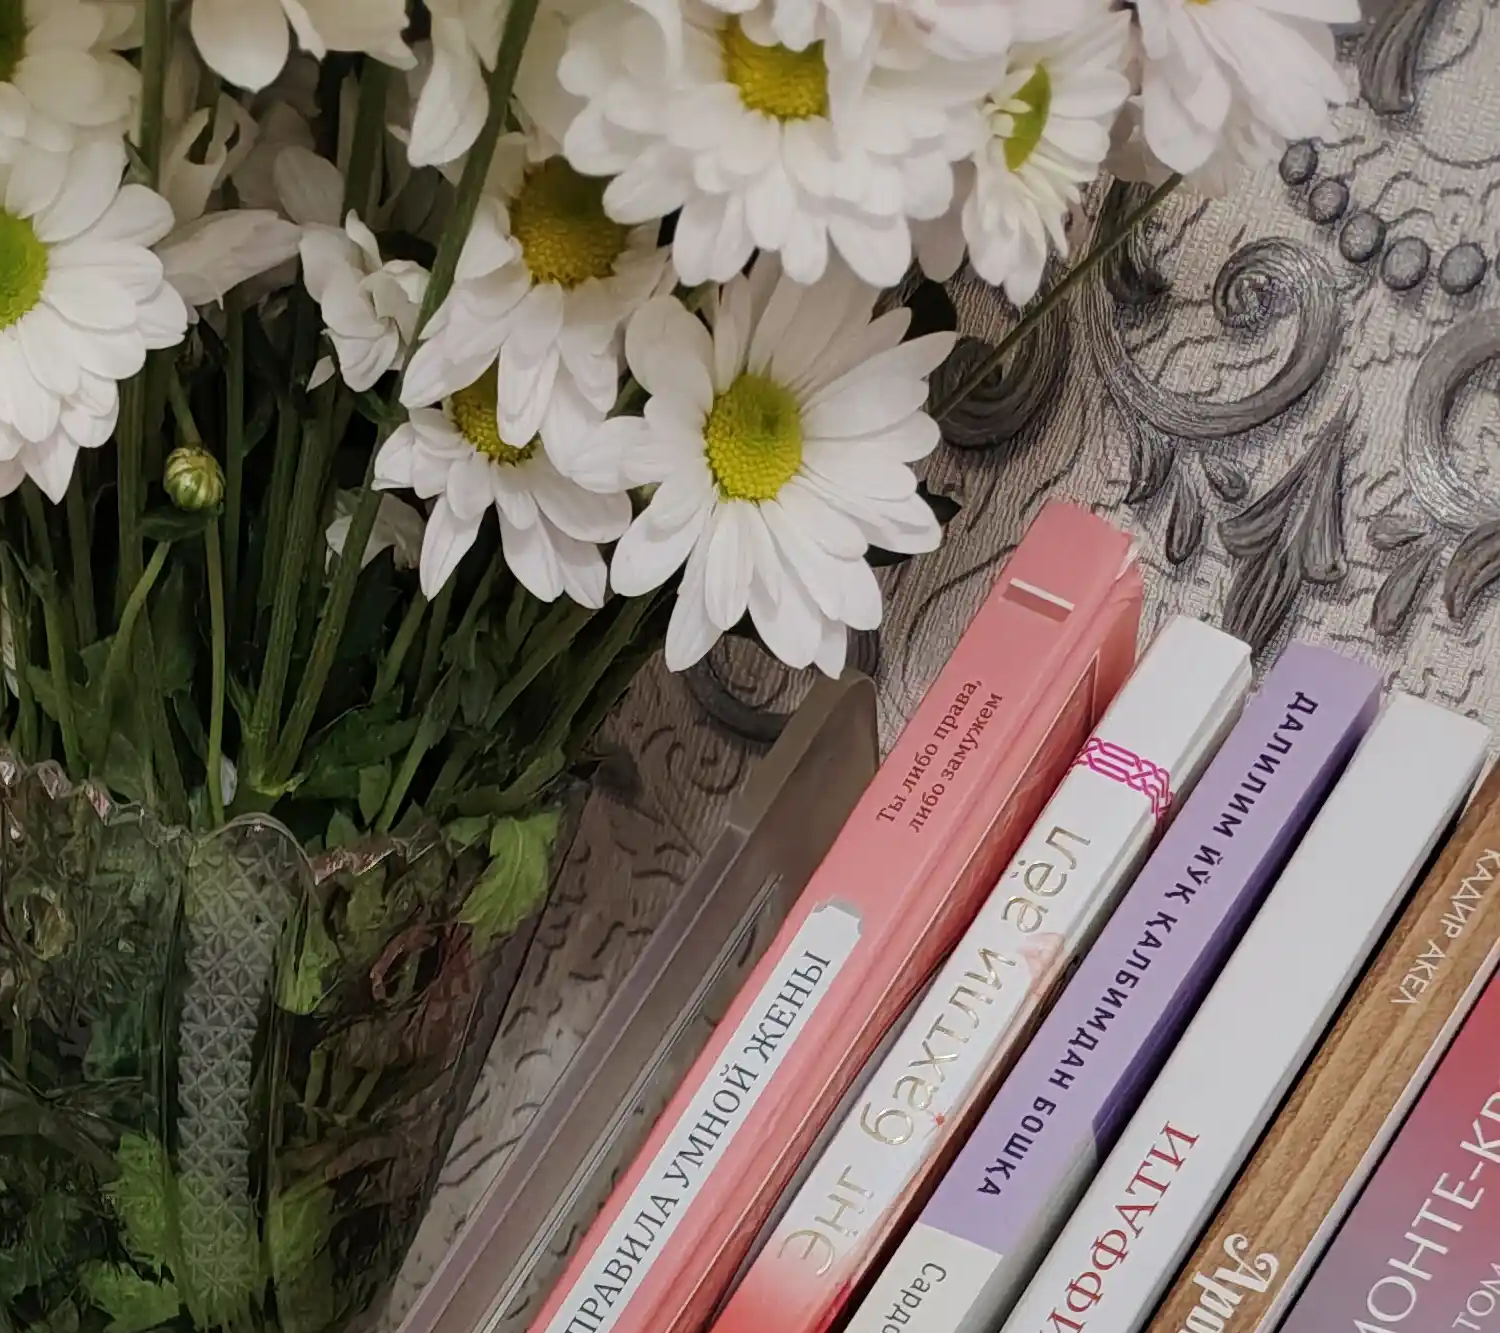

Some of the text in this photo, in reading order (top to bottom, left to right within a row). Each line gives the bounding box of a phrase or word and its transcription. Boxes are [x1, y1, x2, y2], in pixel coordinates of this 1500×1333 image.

[876, 681, 982, 822] Ты либо права,
[909, 693, 1003, 833] либо замужем
[1213, 691, 1318, 838] ДАЛИЛИМ
[859, 942, 1019, 1147] бахтли
[1000, 825, 1093, 935] аёл
[1390, 943, 1446, 1006] АКЕЛ
[665, 1066, 750, 1190] УМНОЙ
[745, 952, 831, 1064] ЖЕНЫ
[977, 1096, 1056, 1195] БОШҚА
